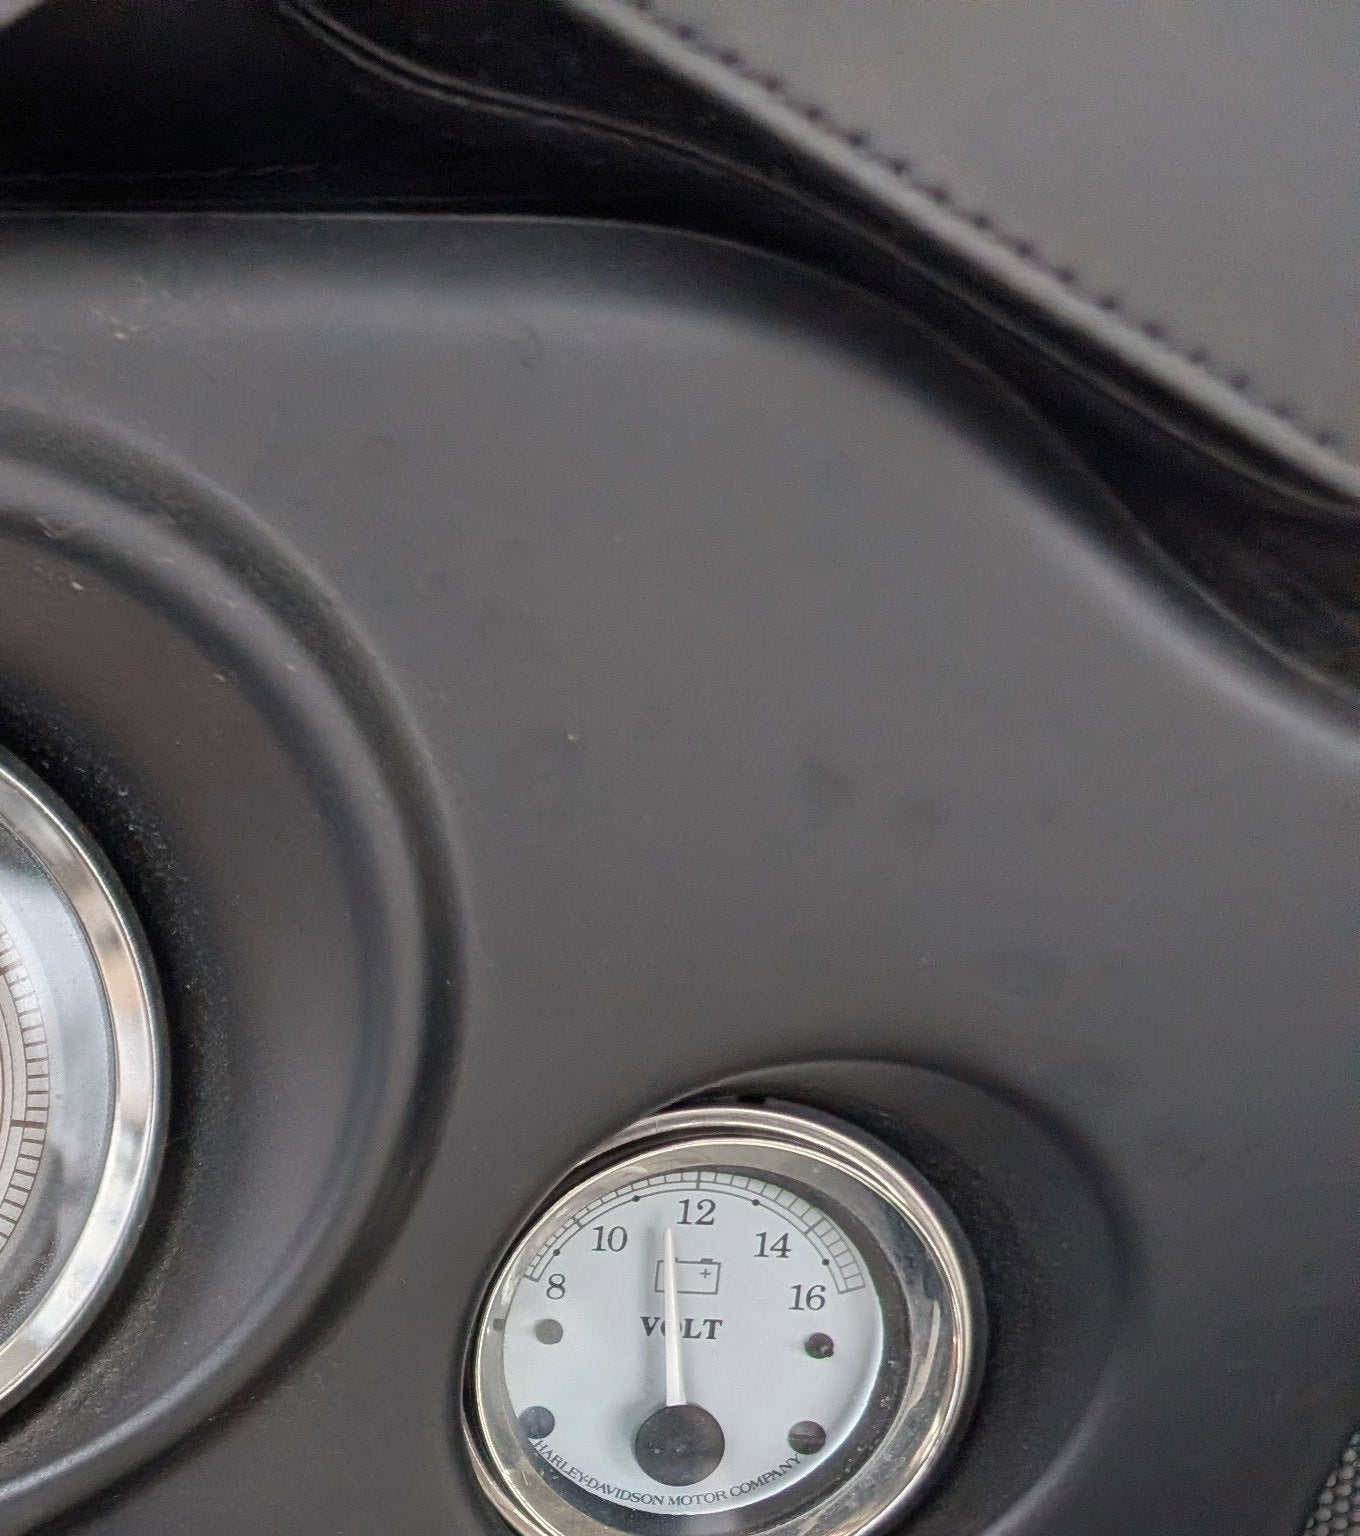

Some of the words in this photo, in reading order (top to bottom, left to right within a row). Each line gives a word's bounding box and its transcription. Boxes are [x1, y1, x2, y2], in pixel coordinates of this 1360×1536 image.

[676, 1199, 715, 1225] 12
[591, 1226, 628, 1252] 10
[753, 1232, 791, 1258] 14
[545, 1274, 566, 1300] 8
[788, 1284, 826, 1311] 16
[535, 1440, 664, 1506] HARLEY-DAVIDSON
[667, 1489, 728, 1507] MOTOR
[730, 1452, 801, 1497] COMPANY
